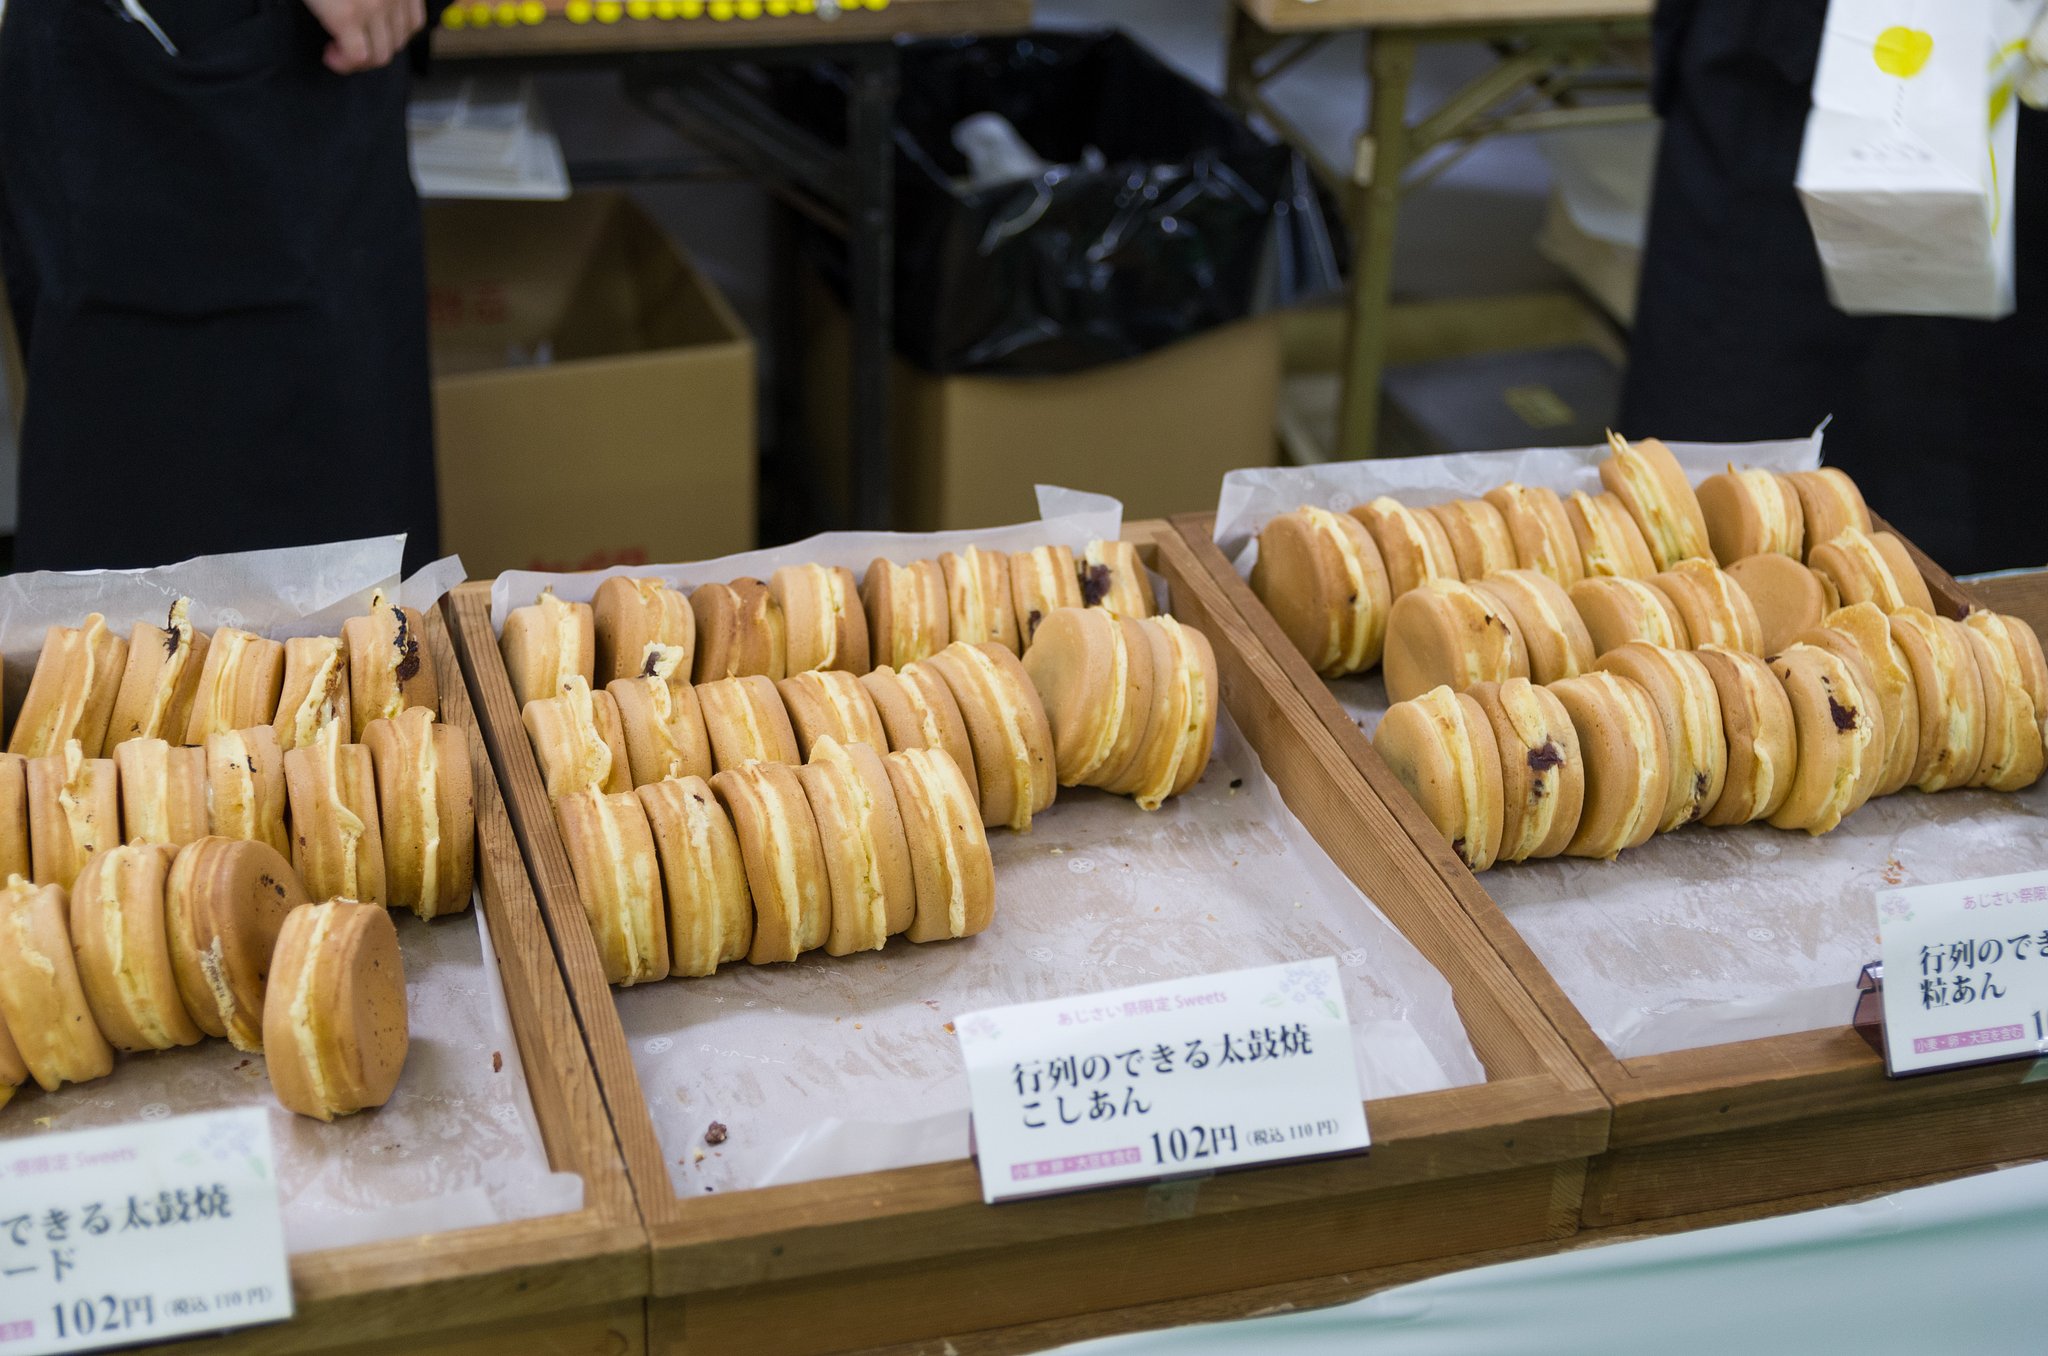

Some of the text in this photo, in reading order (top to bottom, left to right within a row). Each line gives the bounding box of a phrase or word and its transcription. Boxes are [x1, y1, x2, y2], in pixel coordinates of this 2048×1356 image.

[1174, 991, 1228, 1009] Sweets
[1919, 972, 2006, 1010] 粒あん
[1013, 1023, 1313, 1095] 行列のできる太鼓焼
[1022, 1086, 1151, 1129] こしあん
[1152, 1124, 1238, 1164] 102円
[52, 1294, 154, 1339] 102円
